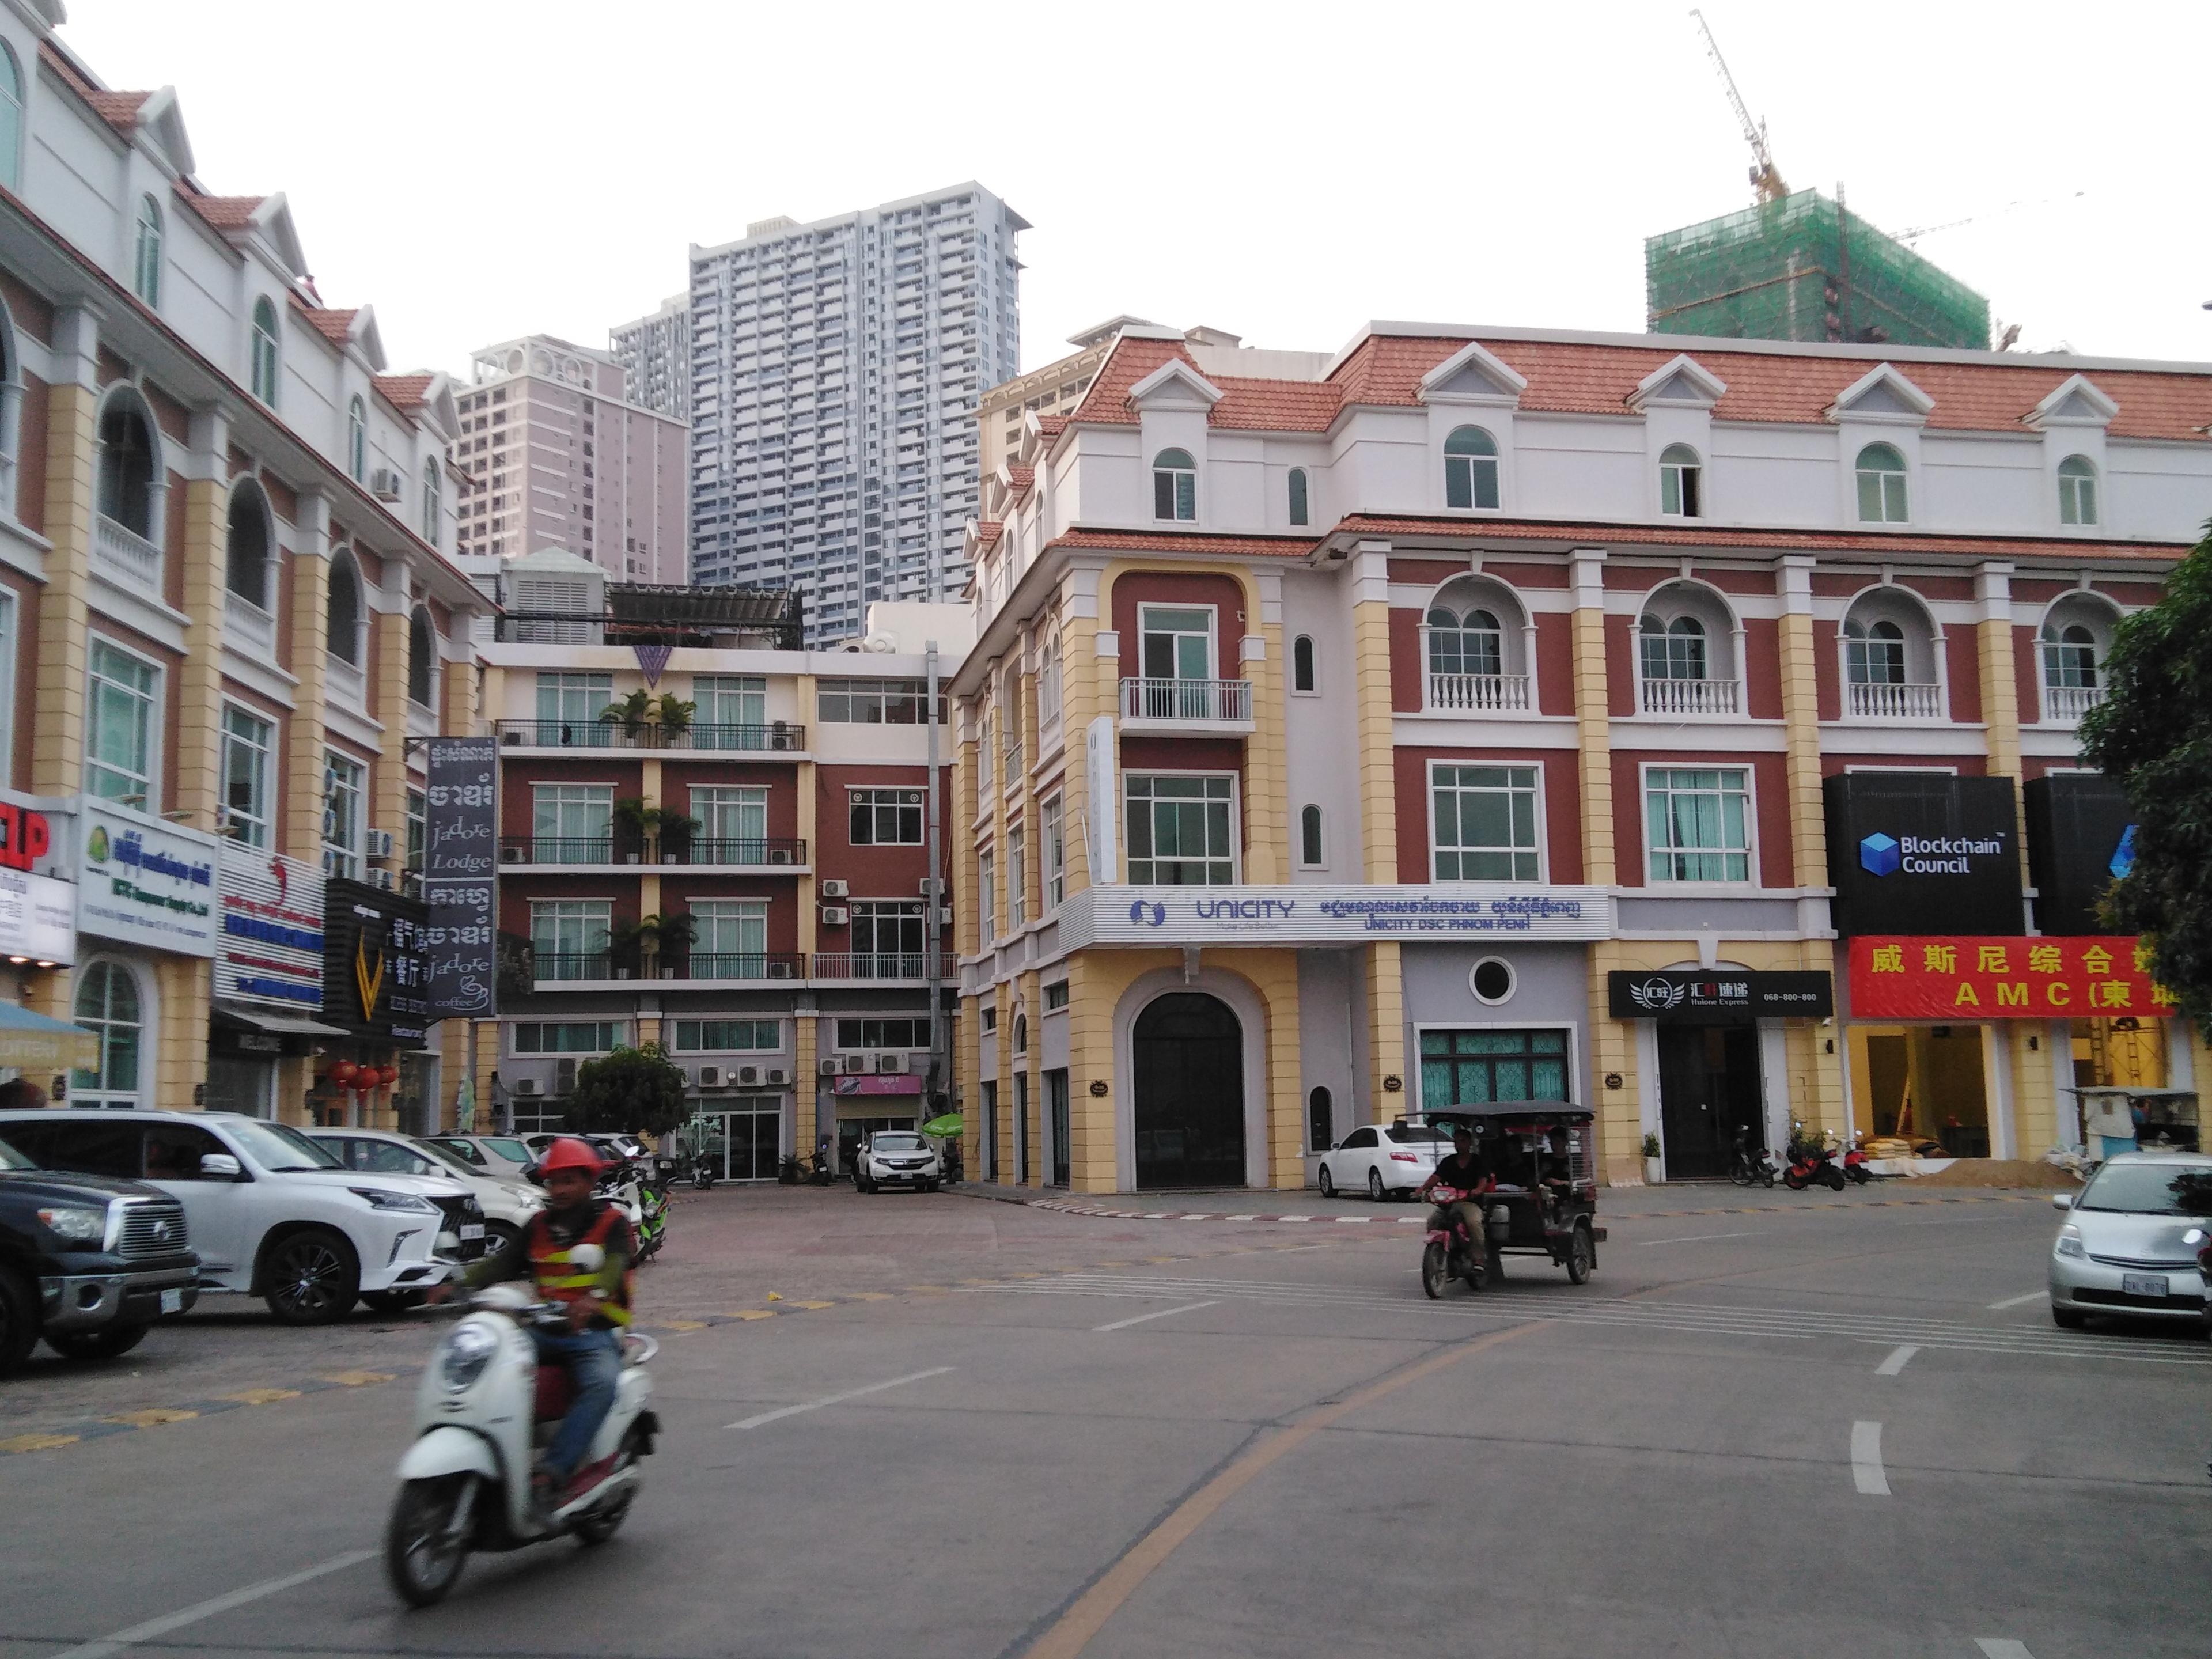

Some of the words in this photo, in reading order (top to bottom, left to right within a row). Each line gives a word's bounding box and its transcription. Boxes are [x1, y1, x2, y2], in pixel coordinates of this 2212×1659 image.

[1901, 837, 2001, 854] Blockchain
[433, 854, 491, 872] Lodge
[1903, 857, 1970, 873] Council
[1197, 900, 1294, 918] UNICITY
[1365, 919, 1414, 930] UNICITY
[1418, 919, 1445, 930] DSC
[1449, 919, 1493, 930] PHNOM
[434, 997, 475, 1006] coffee
[1719, 998, 1749, 1006] Express
[1763, 993, 1816, 1001] 068-800-800
